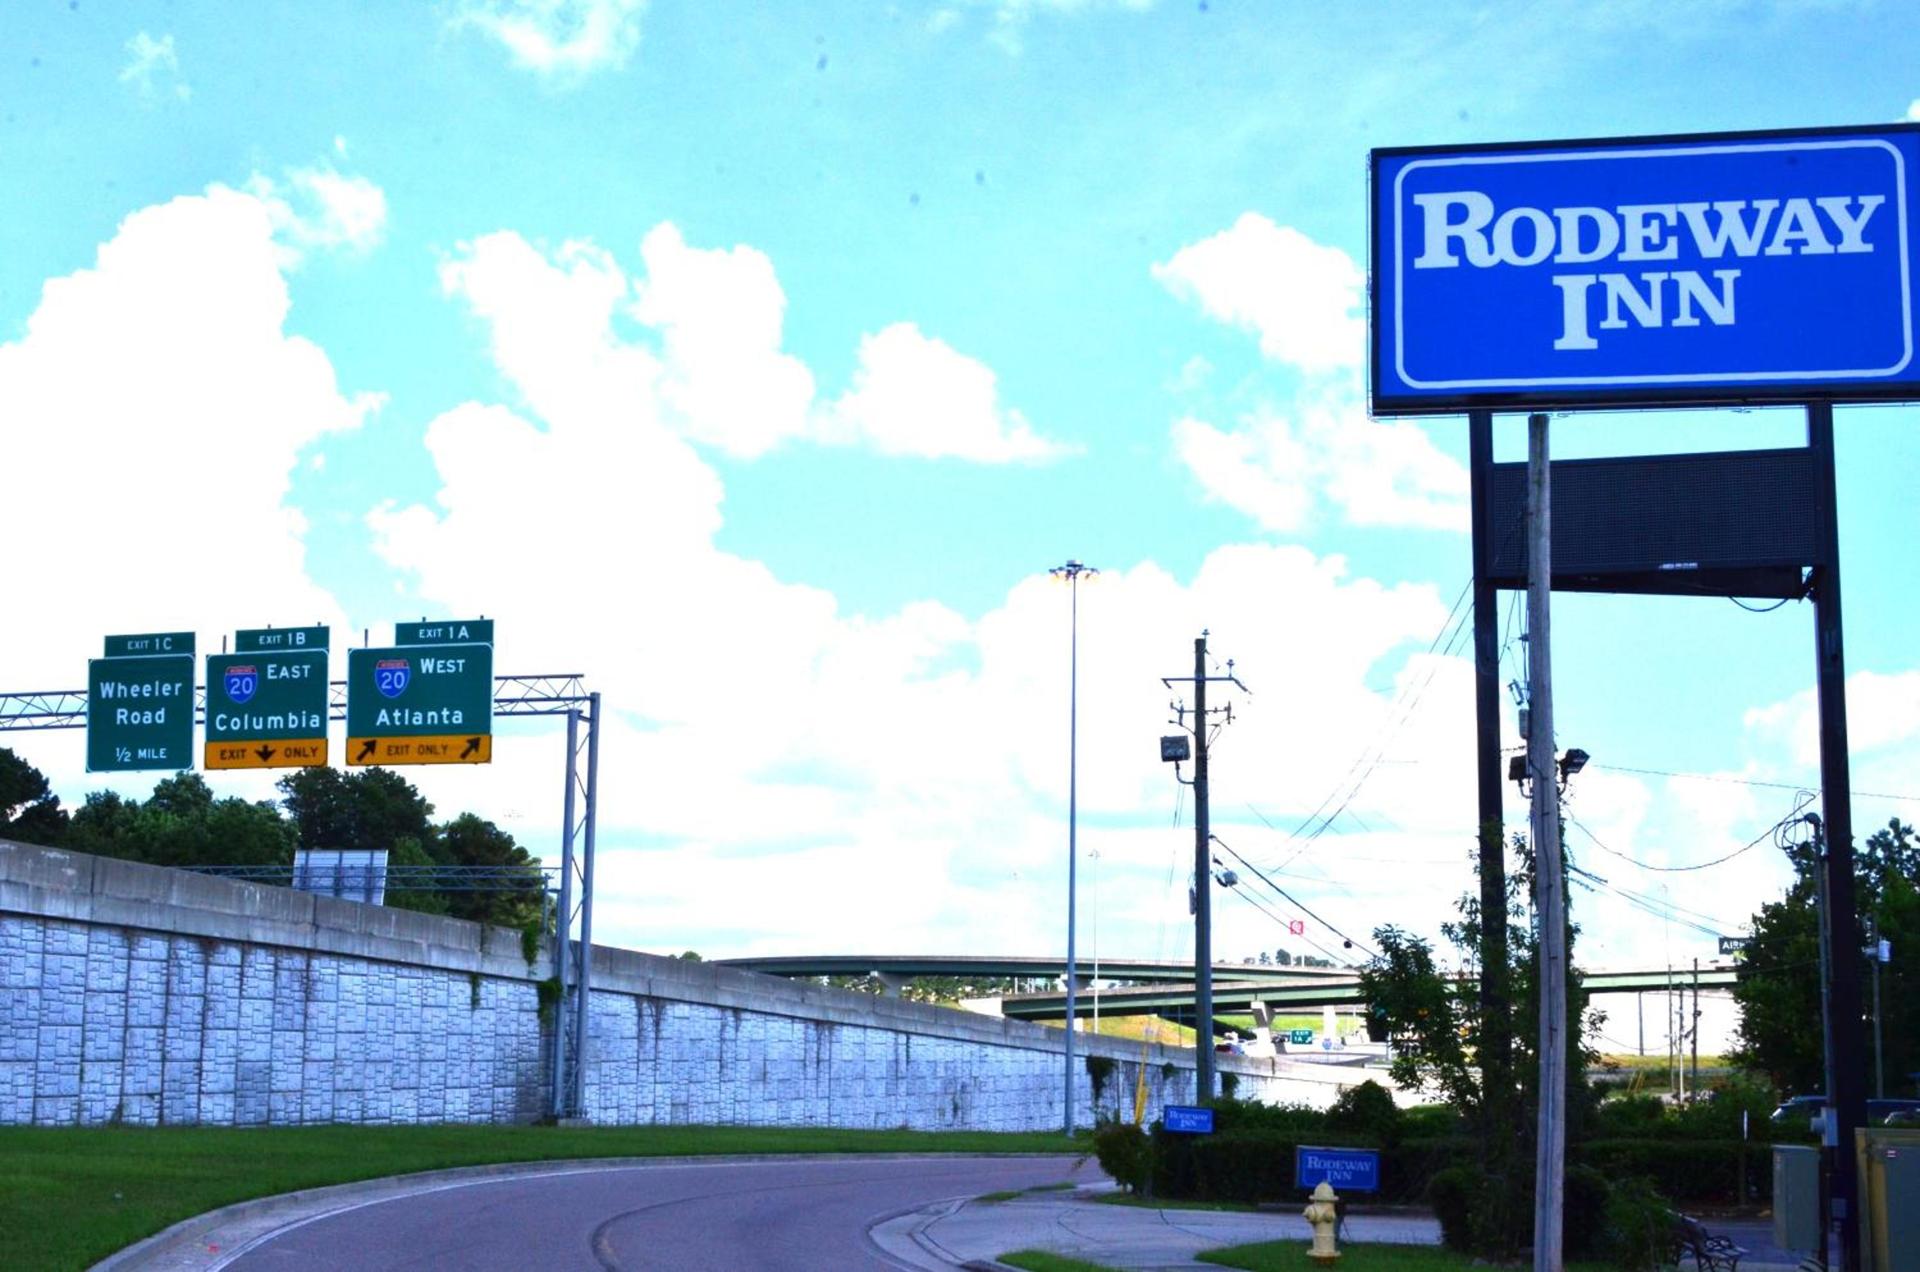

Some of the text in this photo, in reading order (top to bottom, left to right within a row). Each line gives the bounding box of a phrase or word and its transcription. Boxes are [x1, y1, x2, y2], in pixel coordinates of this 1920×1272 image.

[1413, 191, 1885, 269] RODEWAY
[1552, 269, 1742, 351] INN
[259, 632, 306, 645] EXIT 1B
[419, 626, 469, 639] EXIT 1A
[127, 637, 172, 650] EXIT 1C
[267, 664, 311, 679] EAST
[420, 658, 466, 674] WEST
[230, 677, 253, 694] 20
[381, 671, 405, 689] 20
[100, 680, 182, 699] Wheeler
[116, 707, 166, 725] Road
[215, 711, 320, 731] Columbia
[376, 708, 463, 726] Atlanta
[138, 748, 167, 759] MILE
[220, 747, 318, 760] EXIT ONLY
[387, 744, 449, 756] EXIT ONLY
[1307, 1156, 1372, 1171] RODEWAY
[1327, 1170, 1353, 1183] INN
